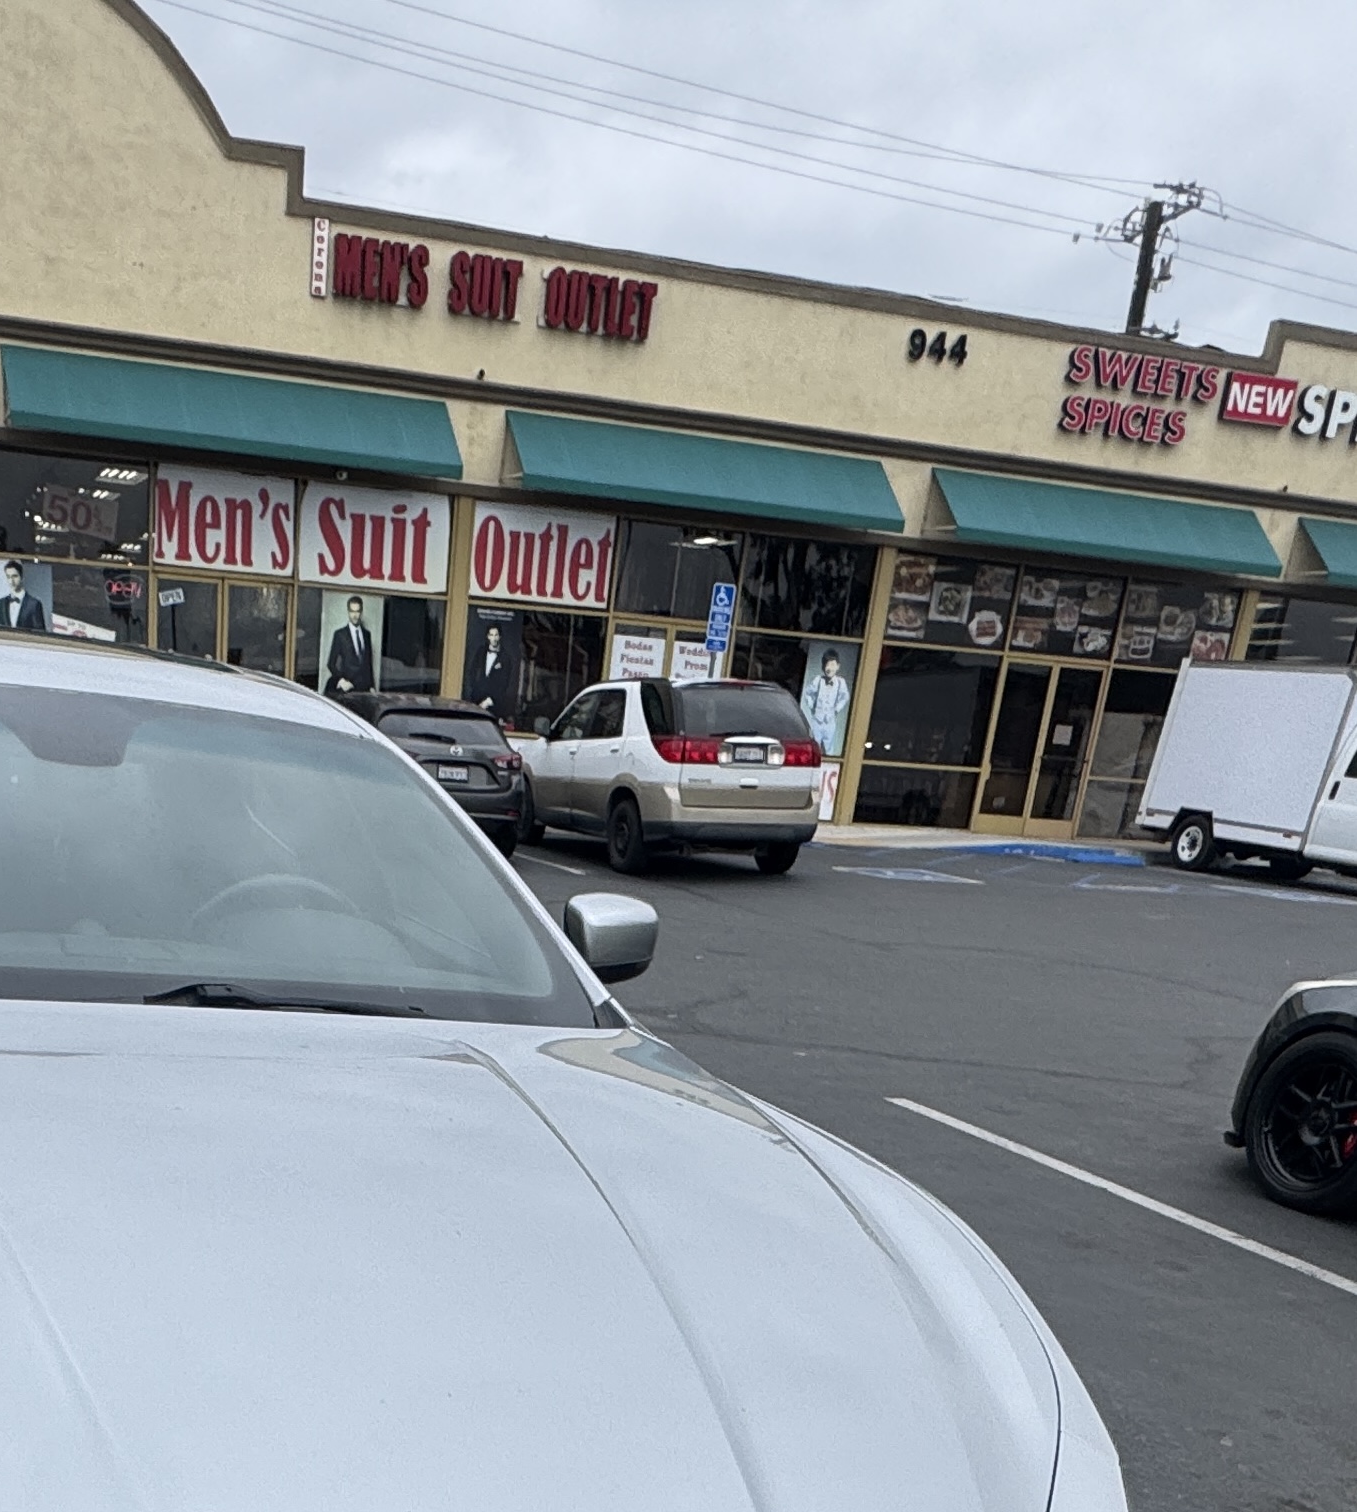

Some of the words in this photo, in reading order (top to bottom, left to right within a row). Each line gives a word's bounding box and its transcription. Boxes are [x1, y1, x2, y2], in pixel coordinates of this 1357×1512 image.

[313, 219, 327, 294] Corona
[333, 232, 430, 310] MEN'S
[448, 250, 524, 321] SUIT
[543, 265, 658, 341] OUTLET
[908, 328, 968, 366] 944
[1069, 344, 1220, 401] SWEETS
[1062, 395, 1187, 444] SPICES
[1226, 381, 1294, 418] NEW
[1296, 384, 1357, 441] SP
[154, 479, 291, 571] Men's
[318, 497, 432, 585] Suit
[473, 515, 612, 603] Outlet
[620, 654, 654, 666] Fiestas
[624, 640, 653, 651] Bodas
